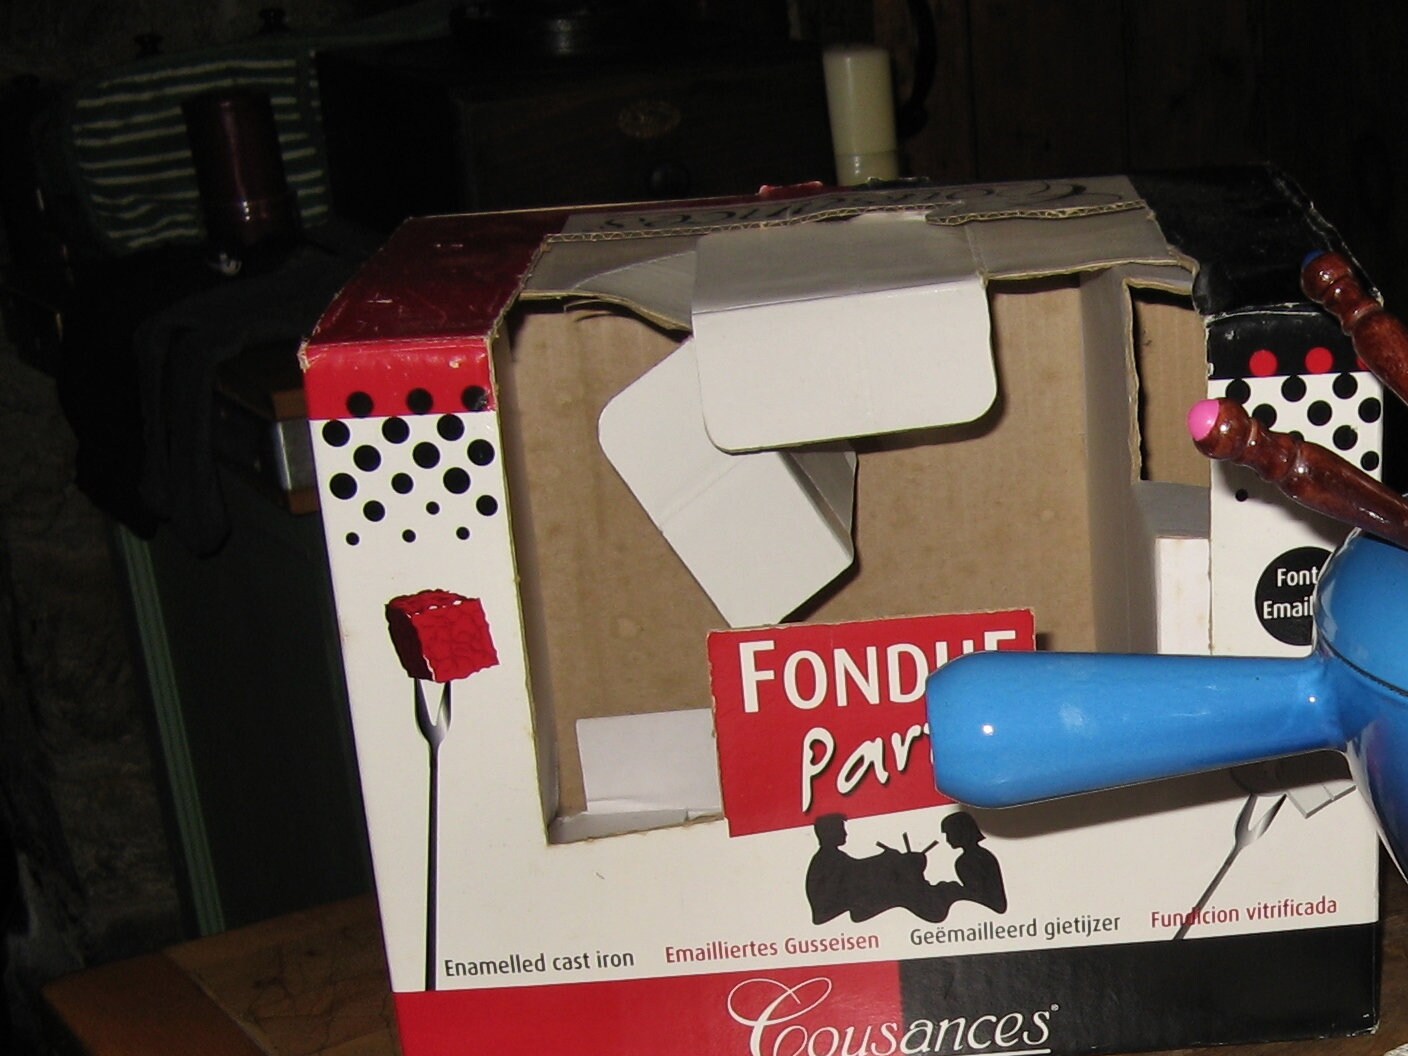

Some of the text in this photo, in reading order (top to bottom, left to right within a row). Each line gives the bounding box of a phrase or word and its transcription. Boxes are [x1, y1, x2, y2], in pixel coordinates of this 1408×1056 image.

[738, 629, 1017, 713] FOND
[802, 721, 936, 813] Par
[1151, 896, 1338, 929] Fundicion vitrificada
[910, 914, 1121, 946] Geëmailleerd gietijzer
[665, 932, 880, 963] Emailliertes Gusseisen
[444, 951, 634, 977] Enamelled cast iron
